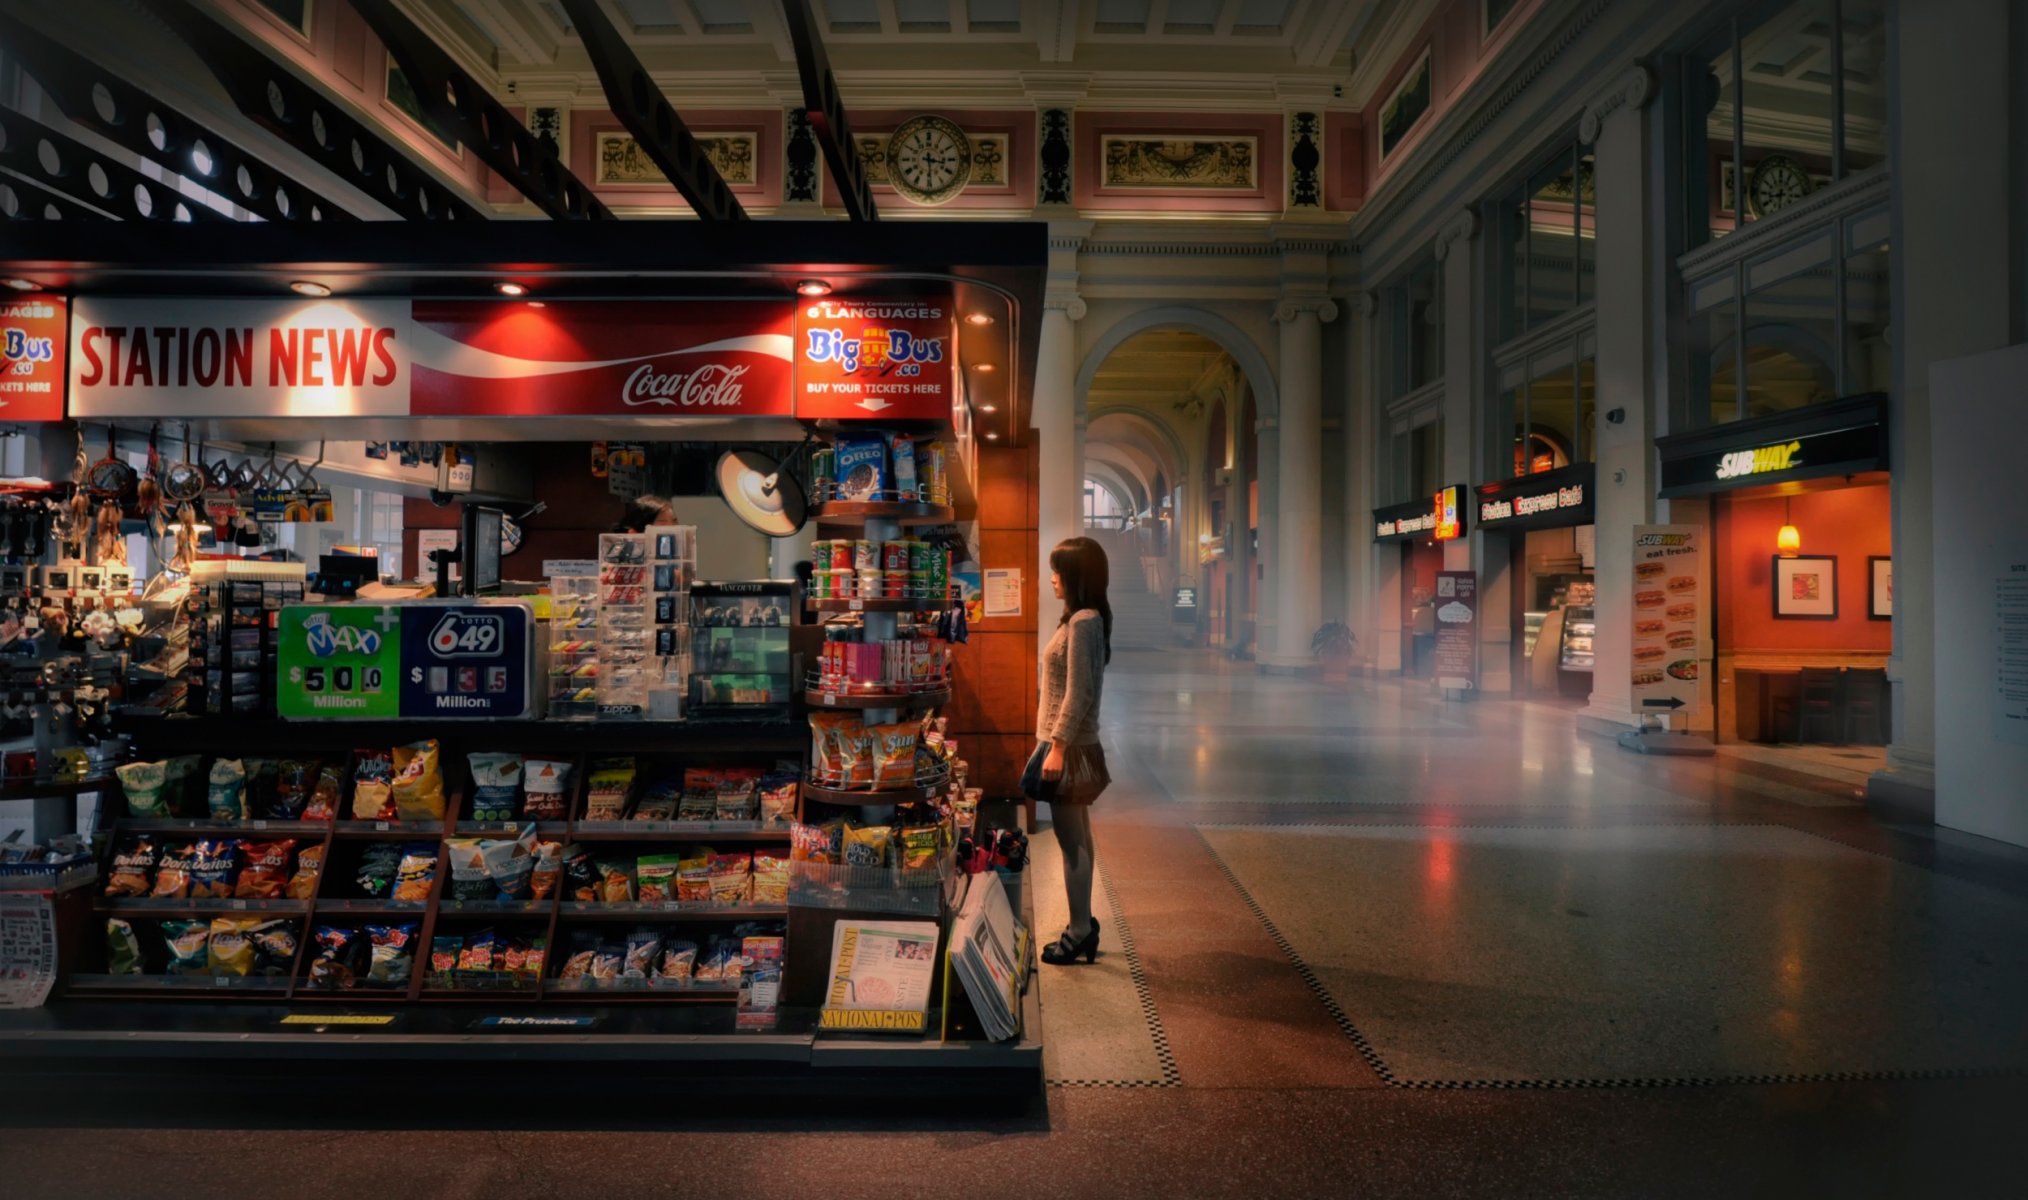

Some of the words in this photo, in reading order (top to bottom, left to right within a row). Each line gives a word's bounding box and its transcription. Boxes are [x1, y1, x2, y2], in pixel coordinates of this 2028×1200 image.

[806, 307, 818, 318] 6
[825, 307, 942, 318] LANGUAGES
[4, 327, 53, 362] Bus
[806, 328, 860, 372] Big
[887, 329, 942, 363] Bus
[80, 326, 254, 388] STATION
[268, 326, 398, 388] NEWS
[621, 363, 751, 408] Coca-Cola
[807, 383, 828, 394] BUY
[832, 383, 861, 394] YOUR
[864, 383, 910, 394] TICKETS
[913, 383, 942, 394] HERE
[840, 450, 881, 465] OREO
[1716, 440, 1802, 480] SUBWAY
[1482, 500, 1512, 520] Station
[1514, 492, 1558, 516] Express
[1638, 533, 1692, 546] SUBWAY
[1646, 550, 1664, 558] eat
[719, 584, 764, 592] VANCOUVER
[306, 620, 382, 657] MAX
[314, 695, 361, 708] Million
[436, 695, 486, 708] Million
[886, 734, 914, 753] Sun
[820, 1010, 885, 1027] NATIONAL
